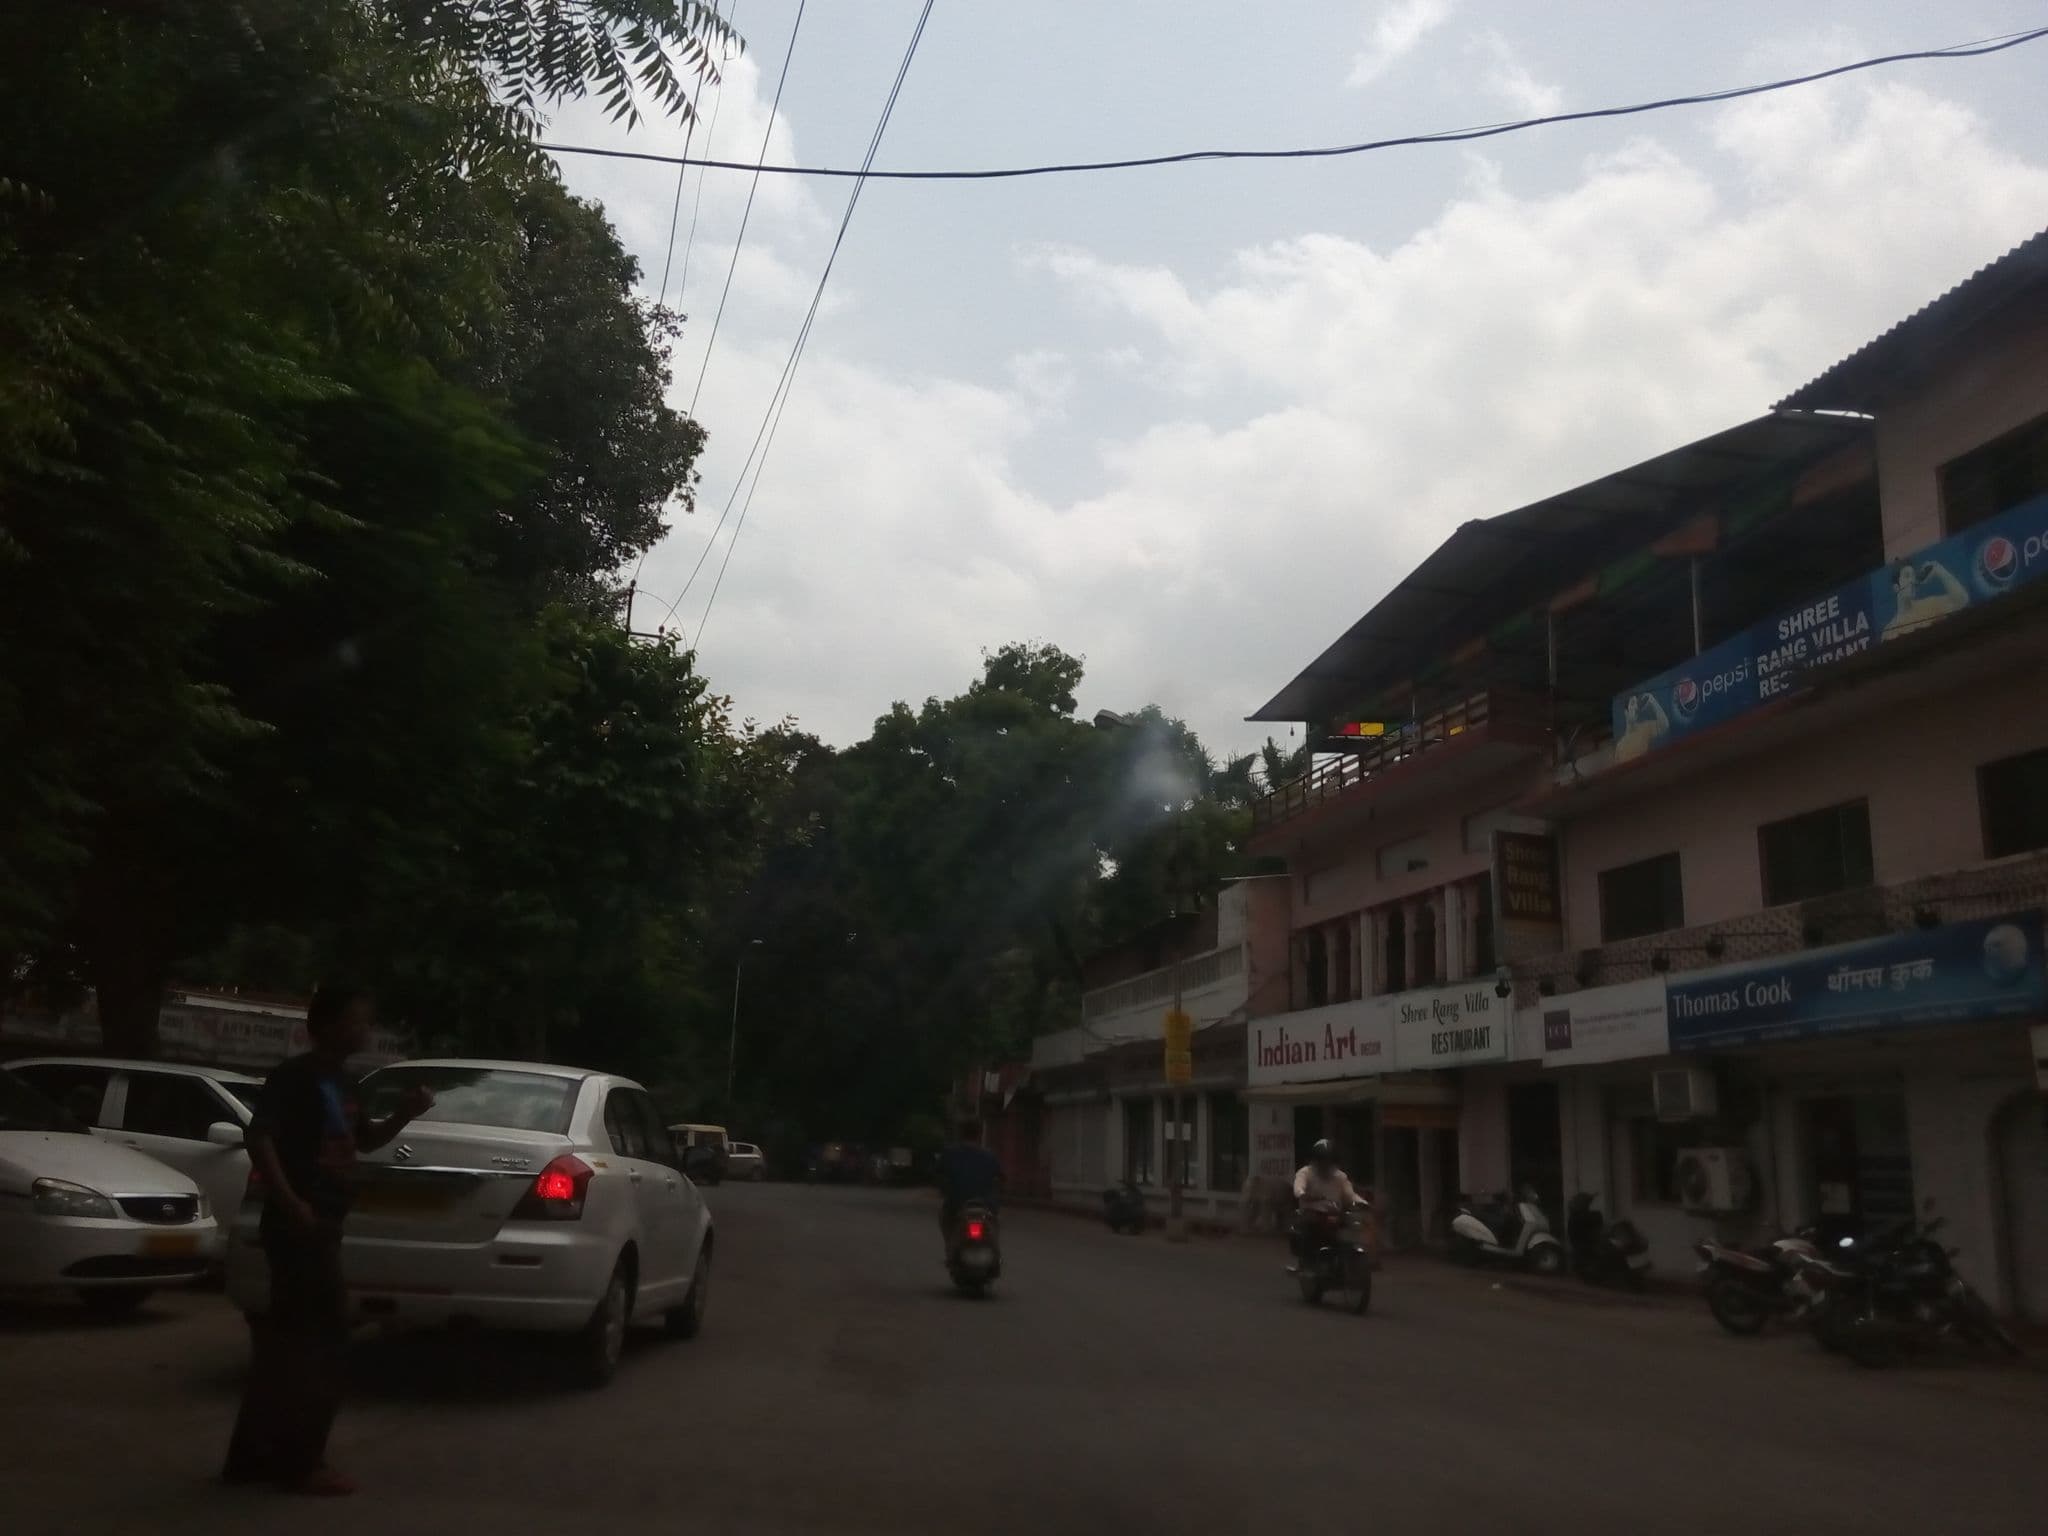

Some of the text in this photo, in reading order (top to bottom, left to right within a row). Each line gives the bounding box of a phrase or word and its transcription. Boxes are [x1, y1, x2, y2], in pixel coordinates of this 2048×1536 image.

[1778, 595, 1840, 640] SHREE
[1757, 611, 1870, 676] RANG VILLA
[1702, 656, 1749, 703] pepsi
[1889, 957, 1935, 992] कुक
[1400, 991, 1489, 1025] Shree Rang Villa
[1671, 992, 1740, 1019] Thomas
[1744, 976, 1793, 1008] Cook
[1257, 1026, 1317, 1067] Indian
[1323, 1022, 1357, 1060] Art
[1431, 1026, 1491, 1055] RESTAURANT
